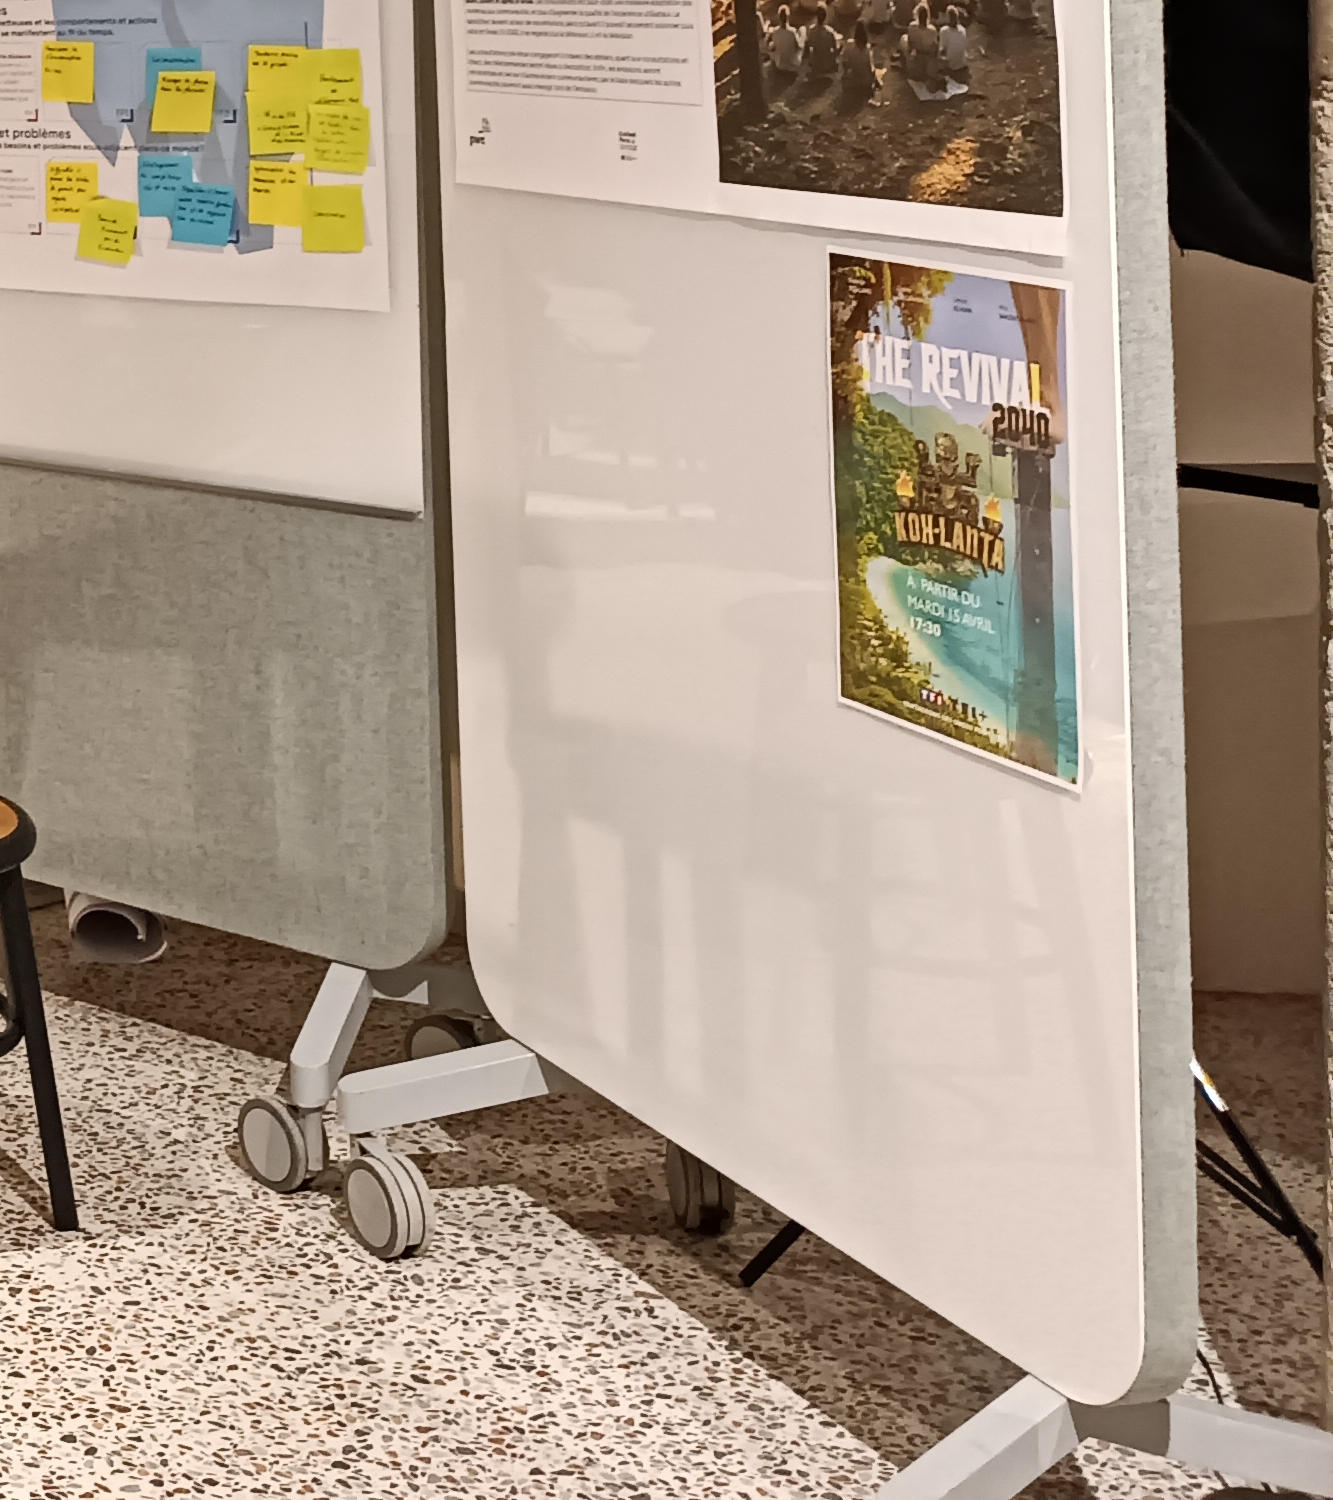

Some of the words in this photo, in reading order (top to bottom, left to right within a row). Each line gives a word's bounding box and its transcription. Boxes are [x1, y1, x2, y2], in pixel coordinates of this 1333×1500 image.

[12, 127, 71, 140] problèmes
[857, 333, 915, 395] THE
[991, 402, 1051, 450] 2040
[894, 511, 1005, 572] KOH-LANTA
[907, 594, 946, 619] MARDI
[946, 607, 961, 623] 15
[961, 612, 996, 635] AVRIL
[920, 578, 960, 602] PARTIR
[961, 590, 981, 609] DU
